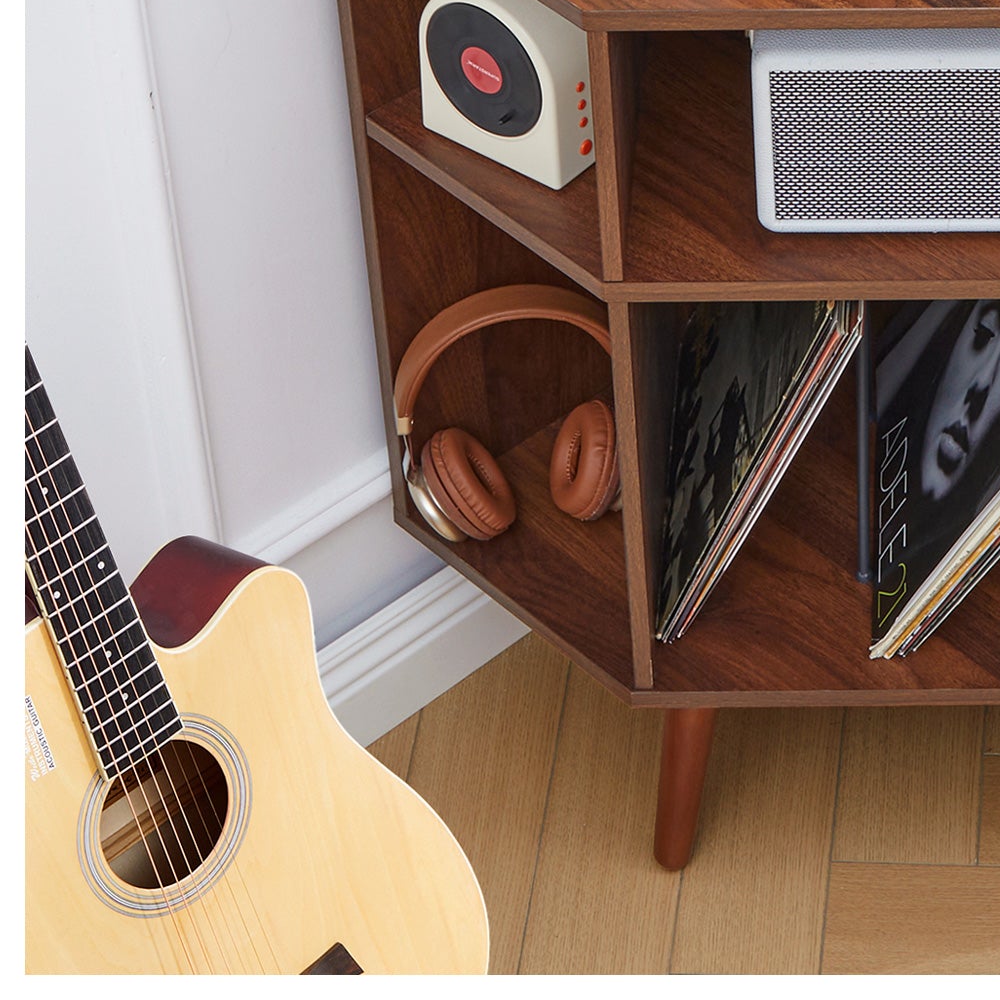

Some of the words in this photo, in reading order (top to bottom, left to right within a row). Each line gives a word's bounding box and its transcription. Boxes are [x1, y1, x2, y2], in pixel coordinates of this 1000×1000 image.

[878, 416, 909, 584] ADELE
[25, 696, 40, 727] GUITAR
[35, 728, 55, 769] ACOUSTIC
